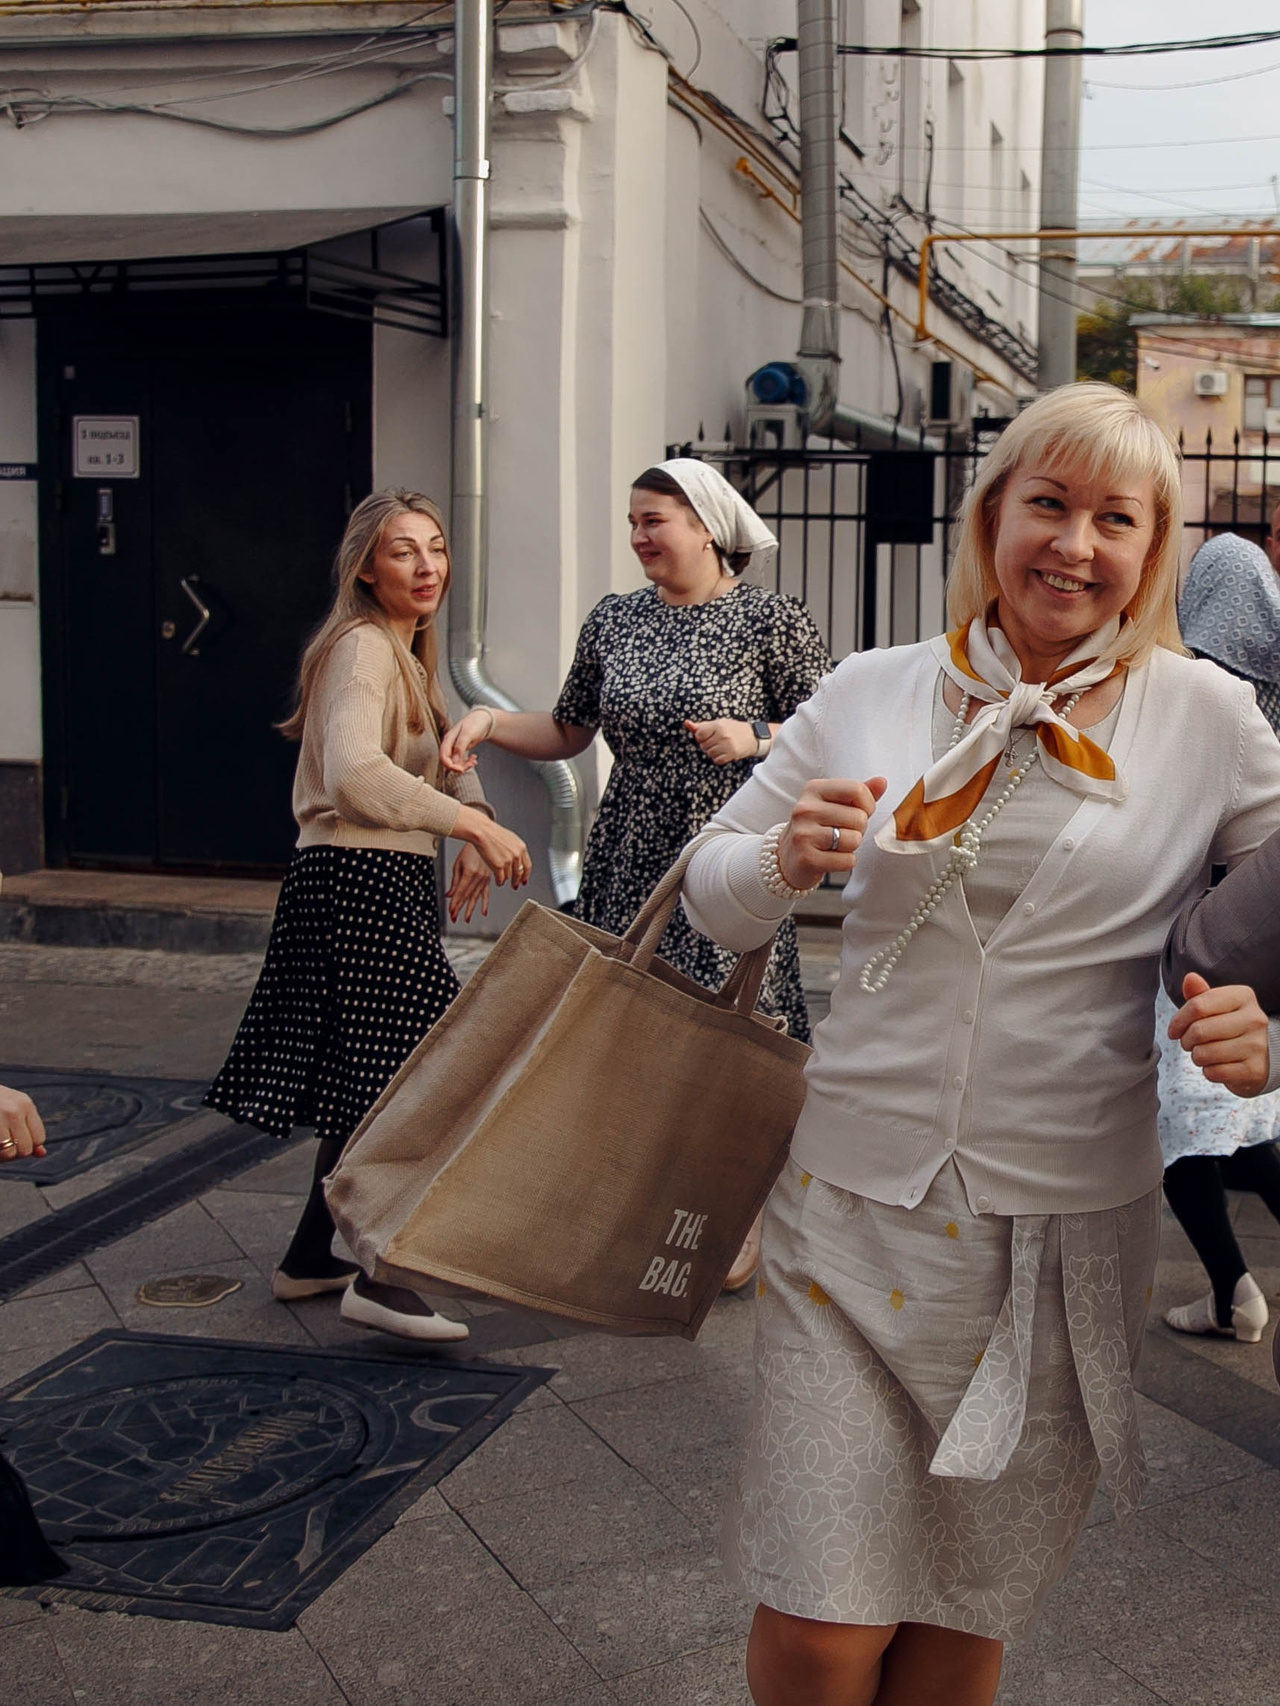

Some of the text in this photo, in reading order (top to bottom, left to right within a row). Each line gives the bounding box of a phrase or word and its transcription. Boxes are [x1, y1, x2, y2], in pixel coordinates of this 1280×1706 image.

[81, 429, 87, 440] 1
[105, 453, 125, 465] 1-3
[665, 1209, 708, 1250] THE
[639, 1256, 692, 1298] BAG.
